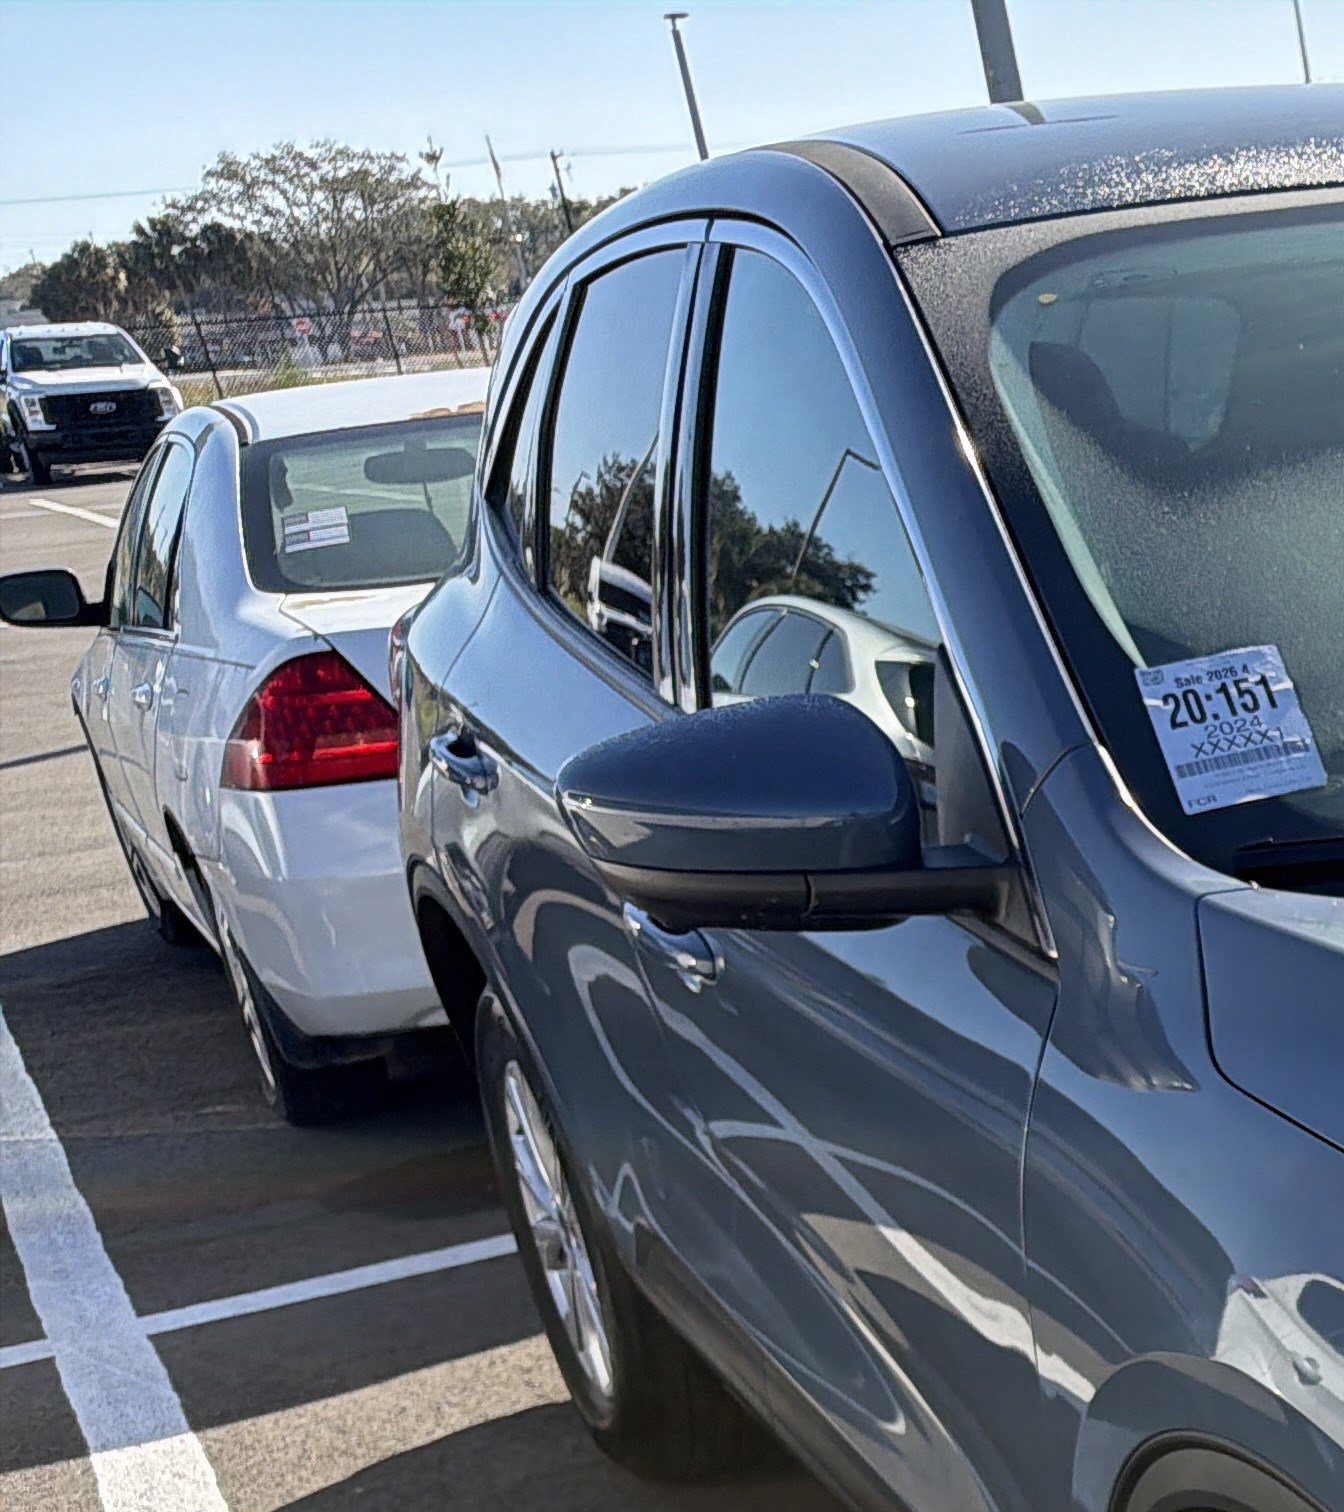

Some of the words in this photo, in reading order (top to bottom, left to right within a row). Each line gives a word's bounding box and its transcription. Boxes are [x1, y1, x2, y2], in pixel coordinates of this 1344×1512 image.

[1174, 674, 1203, 689] Sale
[1162, 674, 1278, 731] 20:151
[1204, 715, 1263, 739] 2024
